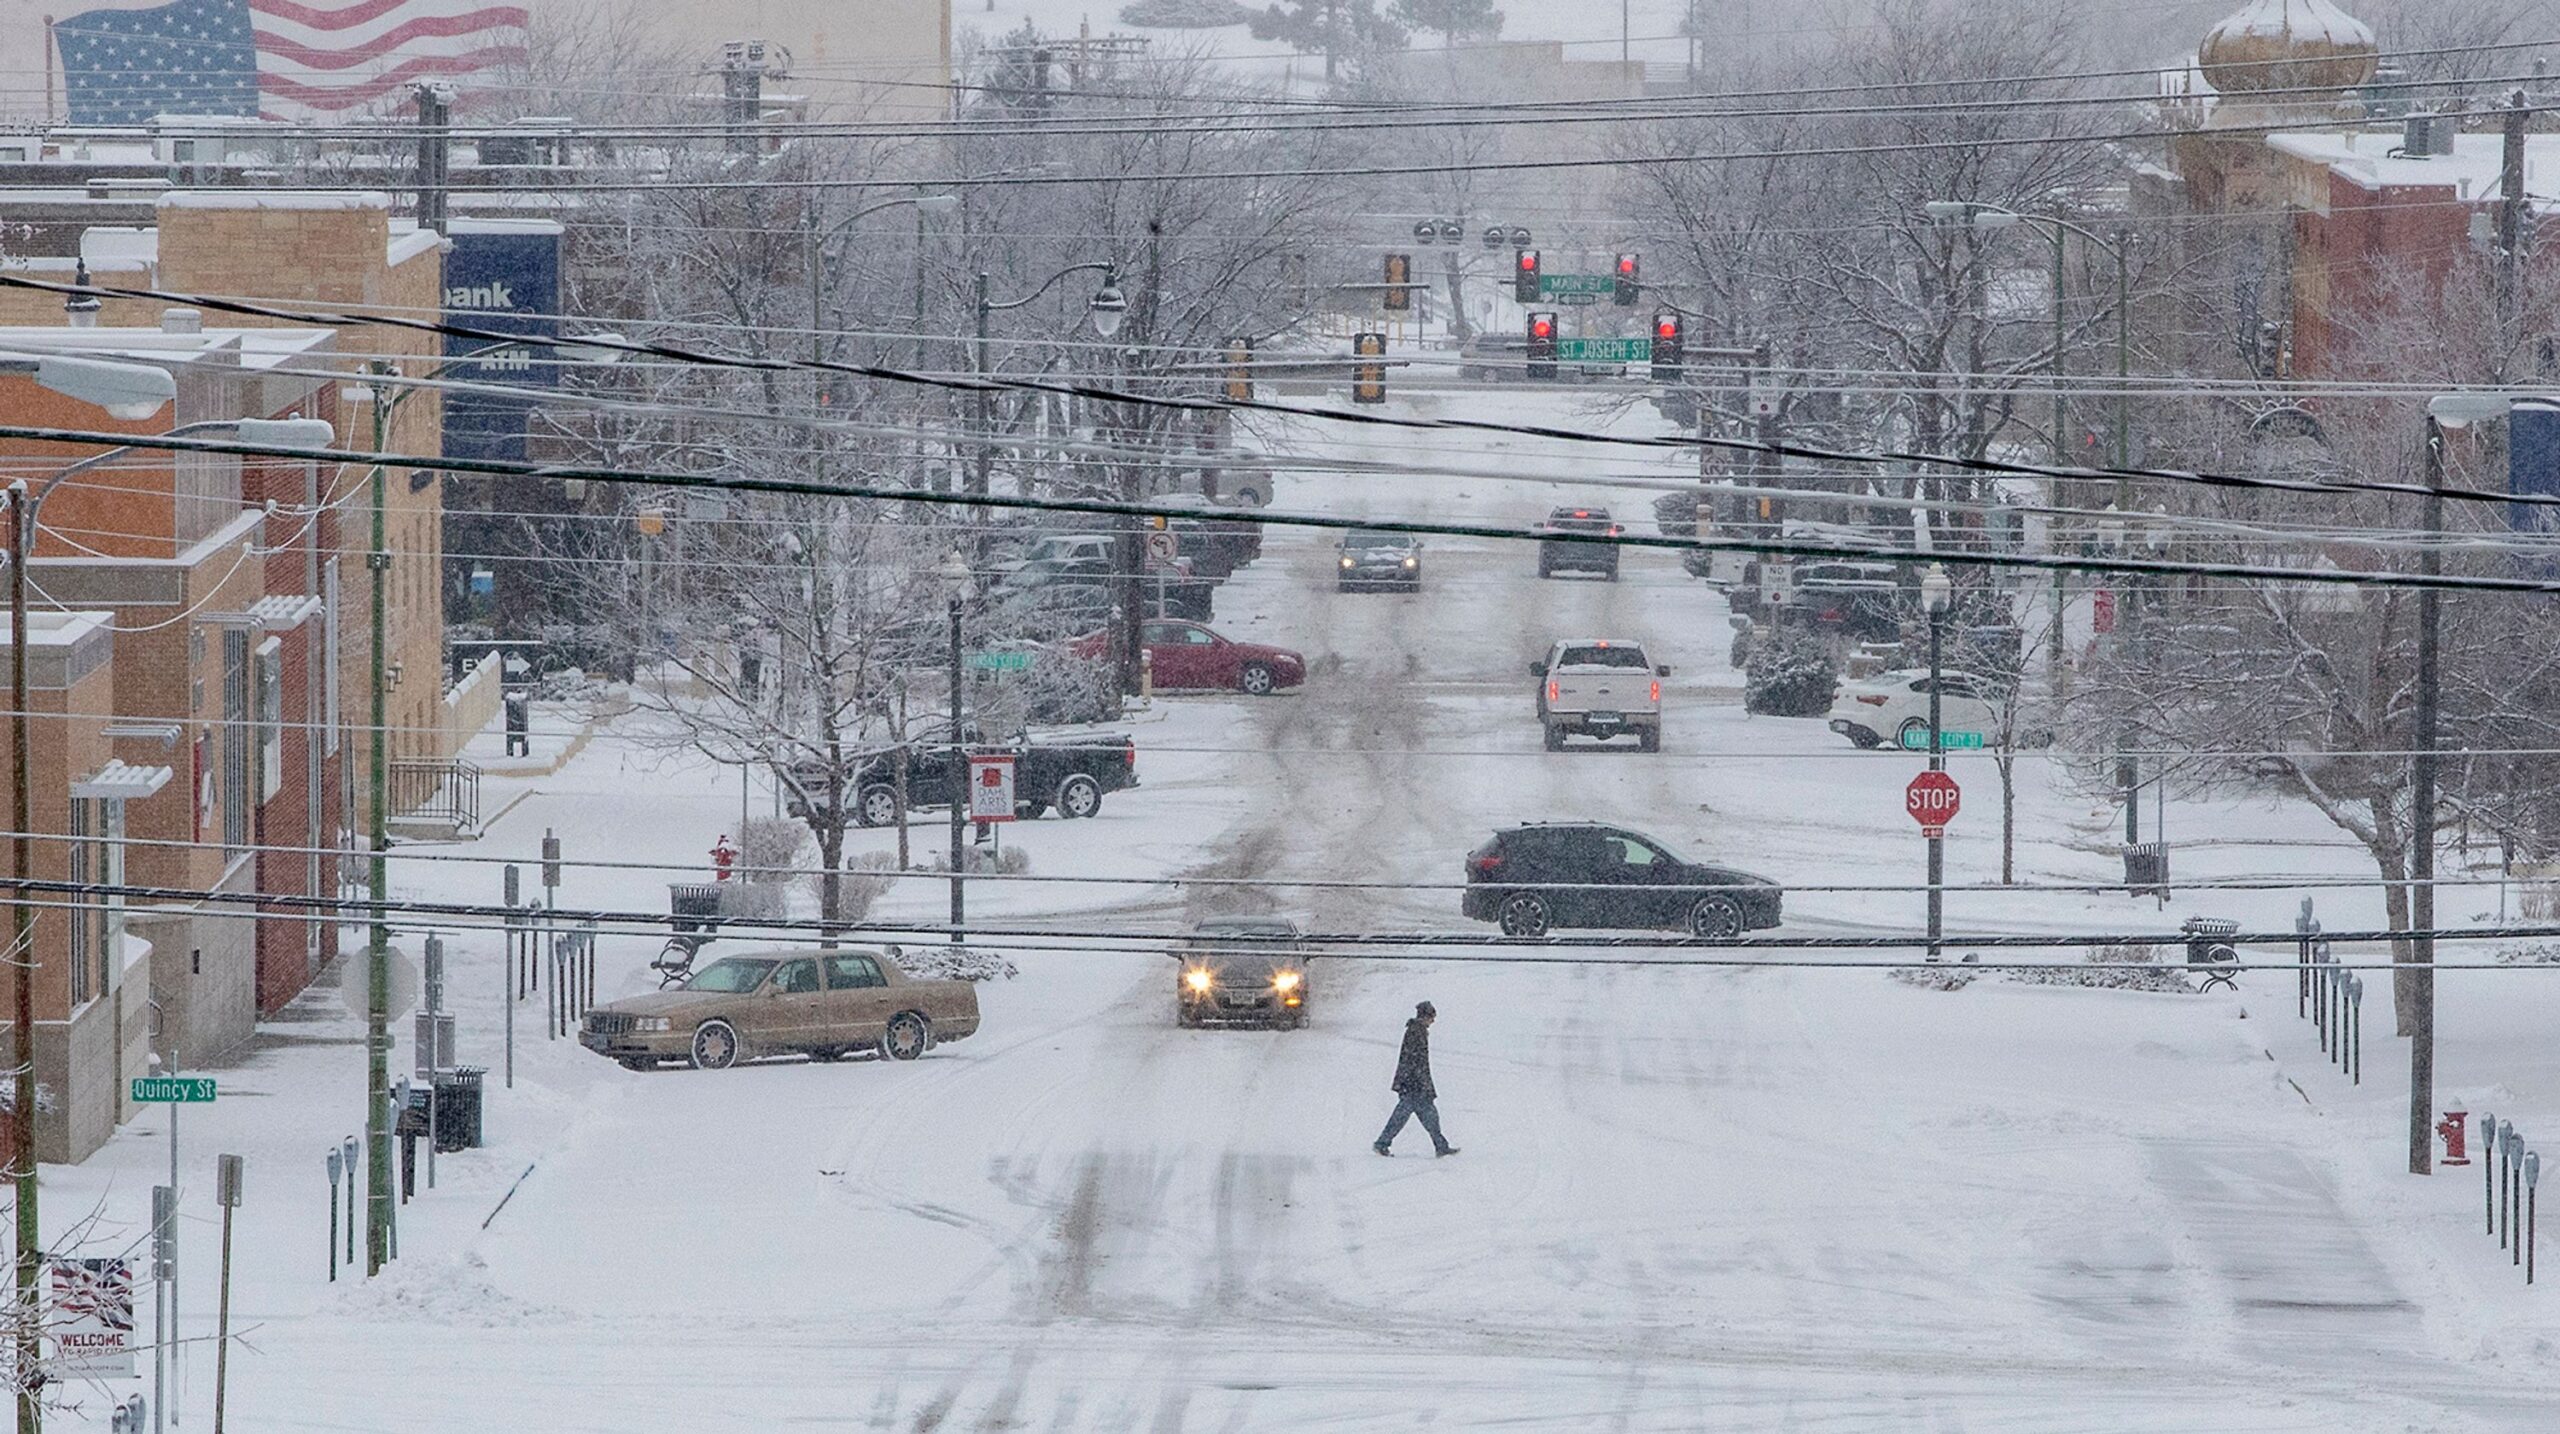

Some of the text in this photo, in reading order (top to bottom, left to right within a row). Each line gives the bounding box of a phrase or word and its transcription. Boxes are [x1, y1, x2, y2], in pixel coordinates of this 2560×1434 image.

[1551, 277, 1602, 290] MAIN ST
[1562, 341, 1576, 358] ST
[1581, 341, 1626, 358] JOSEPH
[481, 351, 530, 370] ATM
[1758, 379, 1771, 387] NO
[1769, 567, 1784, 575] NO
[1946, 733, 1965, 747] CITY
[1969, 733, 1979, 747] ST
[978, 788, 1006, 797] DAHL
[1910, 788, 1957, 809] STOP
[978, 798, 1007, 807] ARTS
[135, 1080, 212, 1101] Quincy St
[61, 1334, 124, 1346] WELCOME
